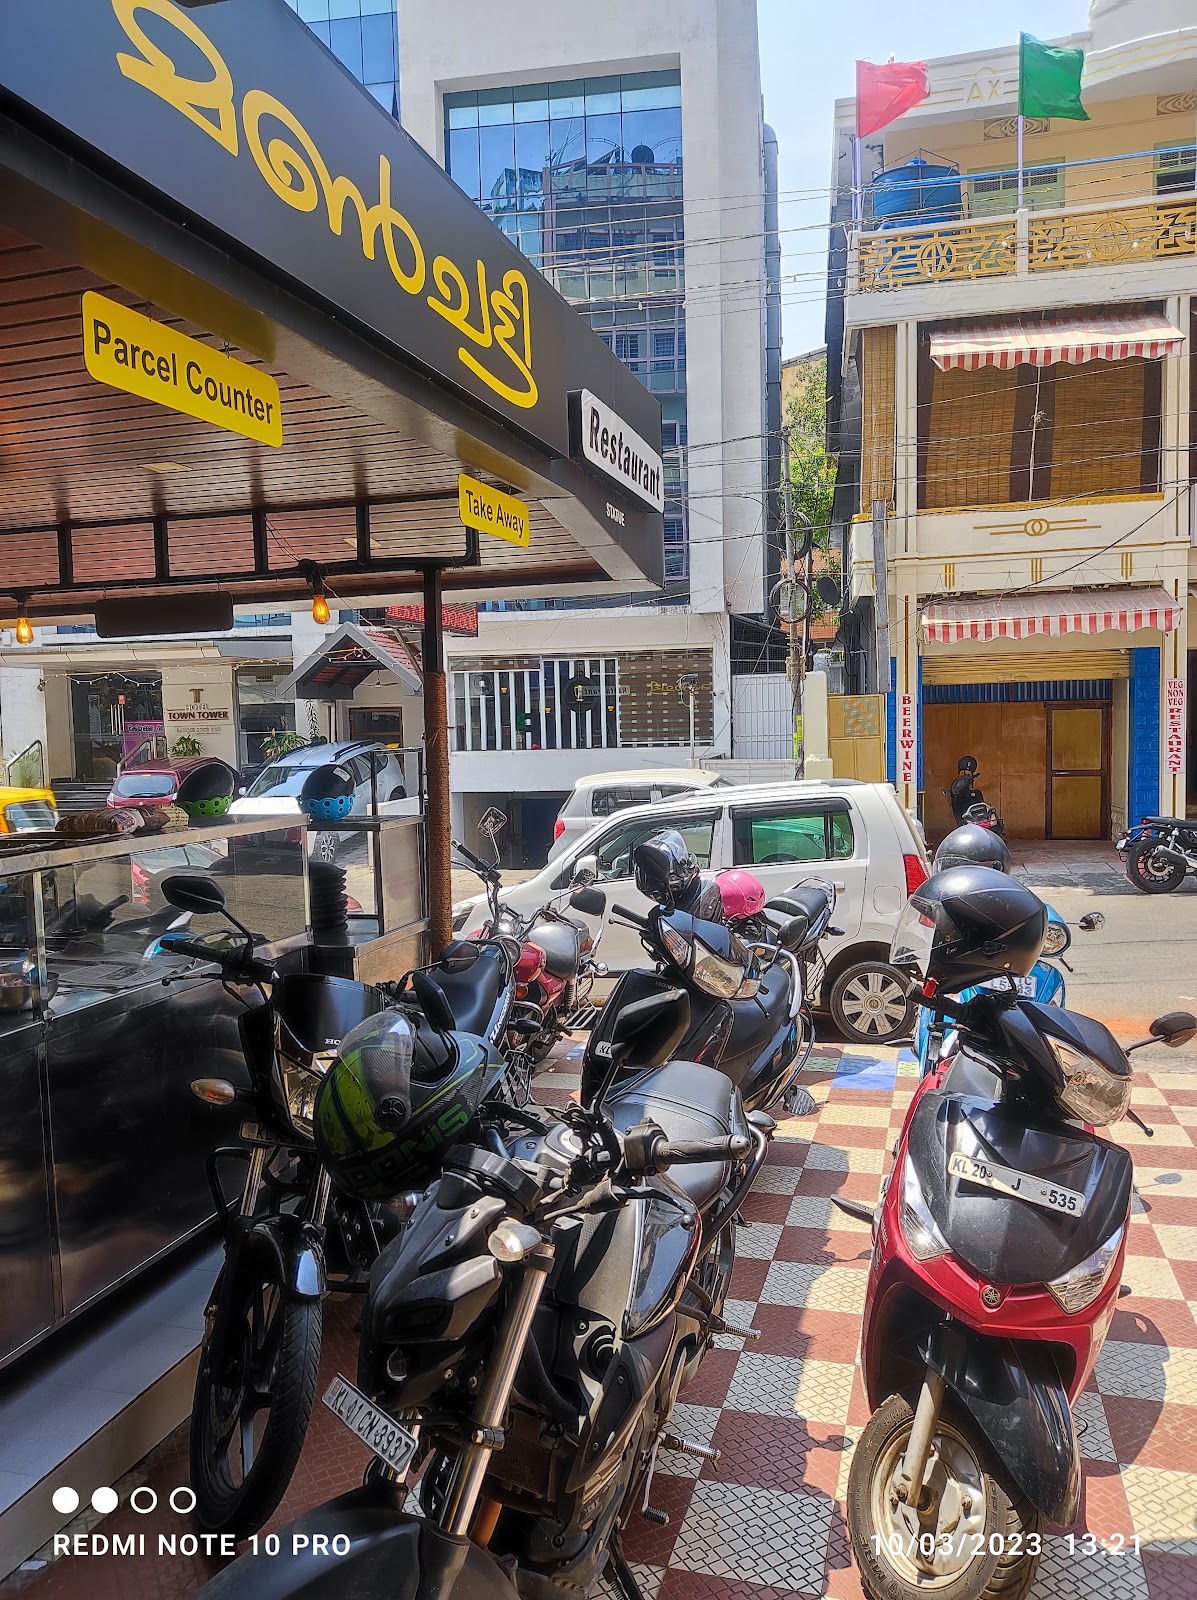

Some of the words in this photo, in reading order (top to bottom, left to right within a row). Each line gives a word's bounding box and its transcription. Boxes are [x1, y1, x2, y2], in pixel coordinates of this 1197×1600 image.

[93, 318, 178, 386] Parcel
[186, 361, 274, 425] Counter
[589, 406, 661, 501] Restaurant
[465, 489, 493, 522] Take
[496, 504, 525, 539] Away
[1167, 689, 1184, 698] NON
[1168, 680, 1184, 689] VEG
[1168, 697, 1184, 706] VEG
[168, 711, 195, 720] TOWN
[197, 711, 229, 719] TOWER
[1168, 707, 1182, 772] RESTAURANT
[952, 1158, 968, 1174] KL
[971, 1163, 987, 1179] 20
[1011, 1178, 1022, 1191] J
[1048, 1189, 1077, 1212] 535
[331, 1386, 350, 1417] KL
[357, 1410, 381, 1440] CN
[373, 1424, 412, 1466] 3937
